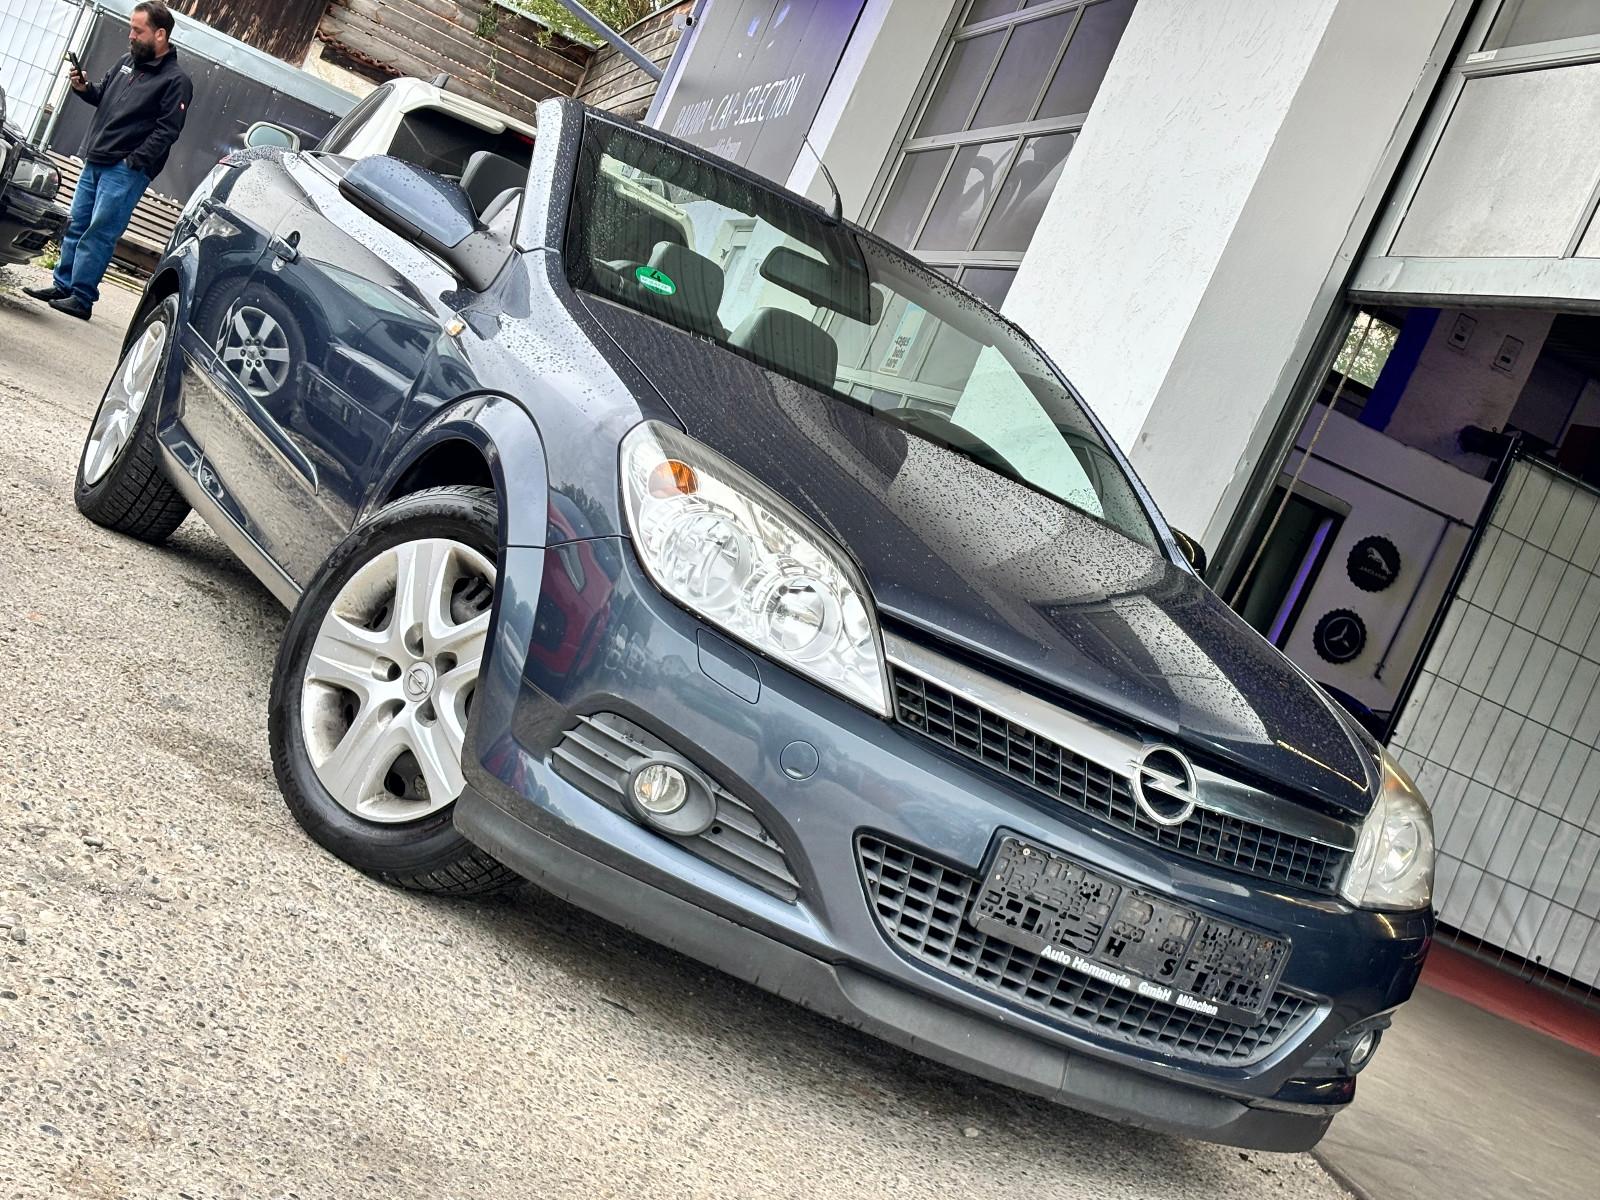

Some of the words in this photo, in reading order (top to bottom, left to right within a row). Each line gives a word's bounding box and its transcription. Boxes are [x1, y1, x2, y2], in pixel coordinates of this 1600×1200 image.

[710, 92, 741, 131] CAR
[734, 73, 806, 126] SELECTION
[650, 270, 661, 282] 4
[1040, 944, 1071, 965] Auto
[1071, 956, 1131, 988] Hemmerle
[1138, 981, 1172, 1002] GmbH
[1175, 993, 1219, 1016] München
